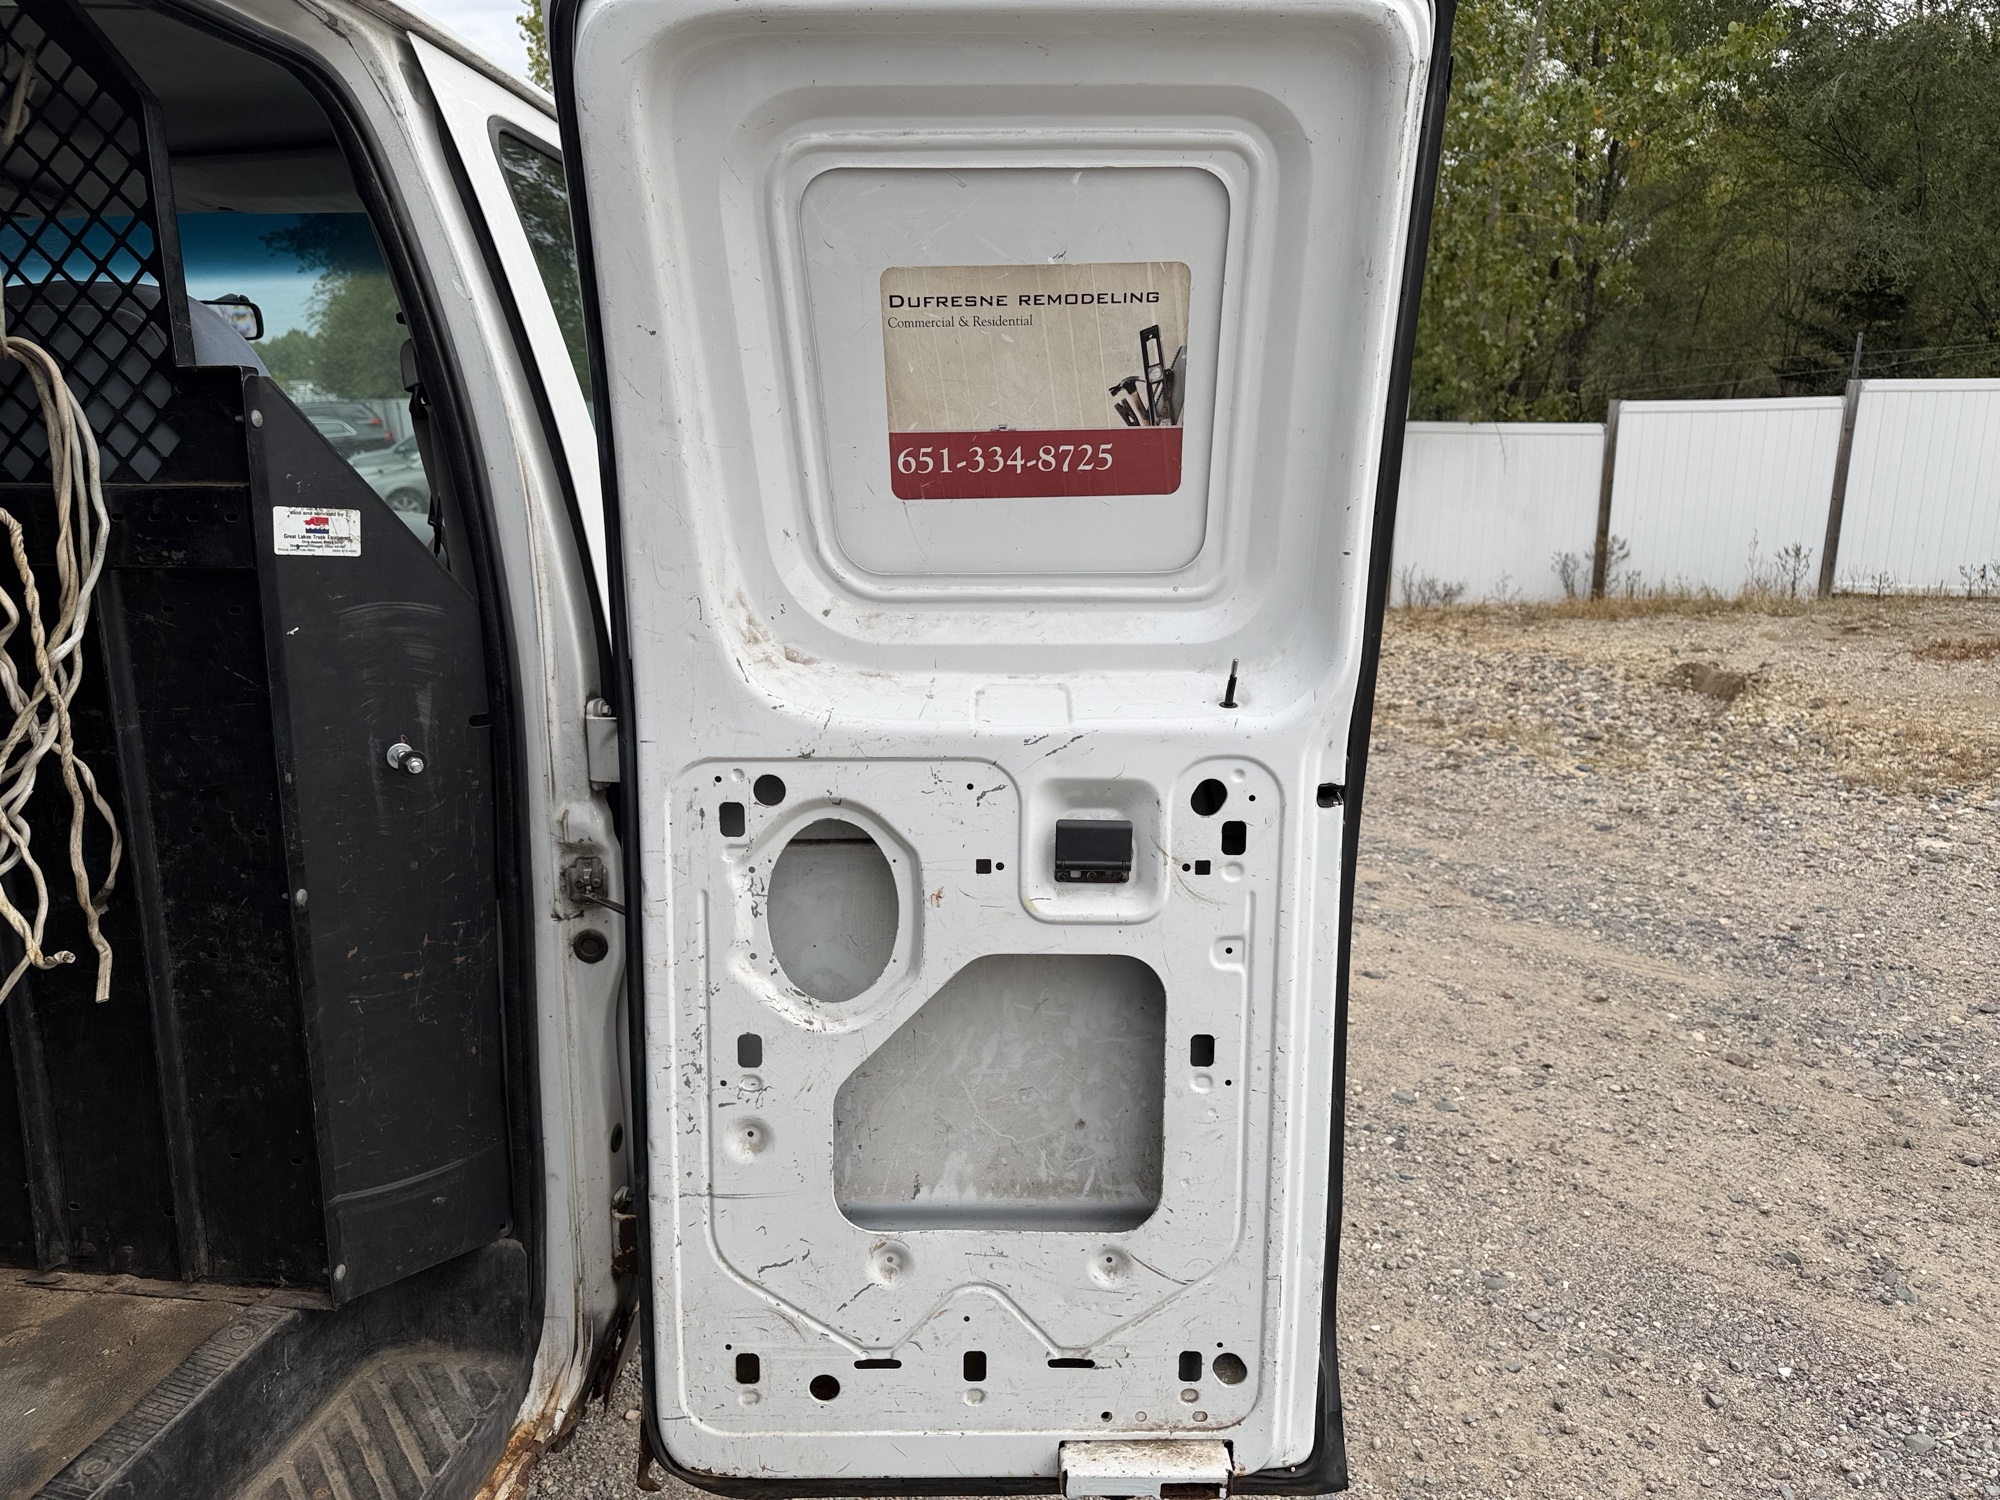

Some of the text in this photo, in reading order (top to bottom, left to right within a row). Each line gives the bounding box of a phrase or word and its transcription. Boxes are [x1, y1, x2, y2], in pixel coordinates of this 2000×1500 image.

[889, 291, 1160, 309] DUFRESNE REMODELING
[888, 314, 1033, 329] Commercial & Residential
[897, 443, 1113, 474] 651-334-8725
